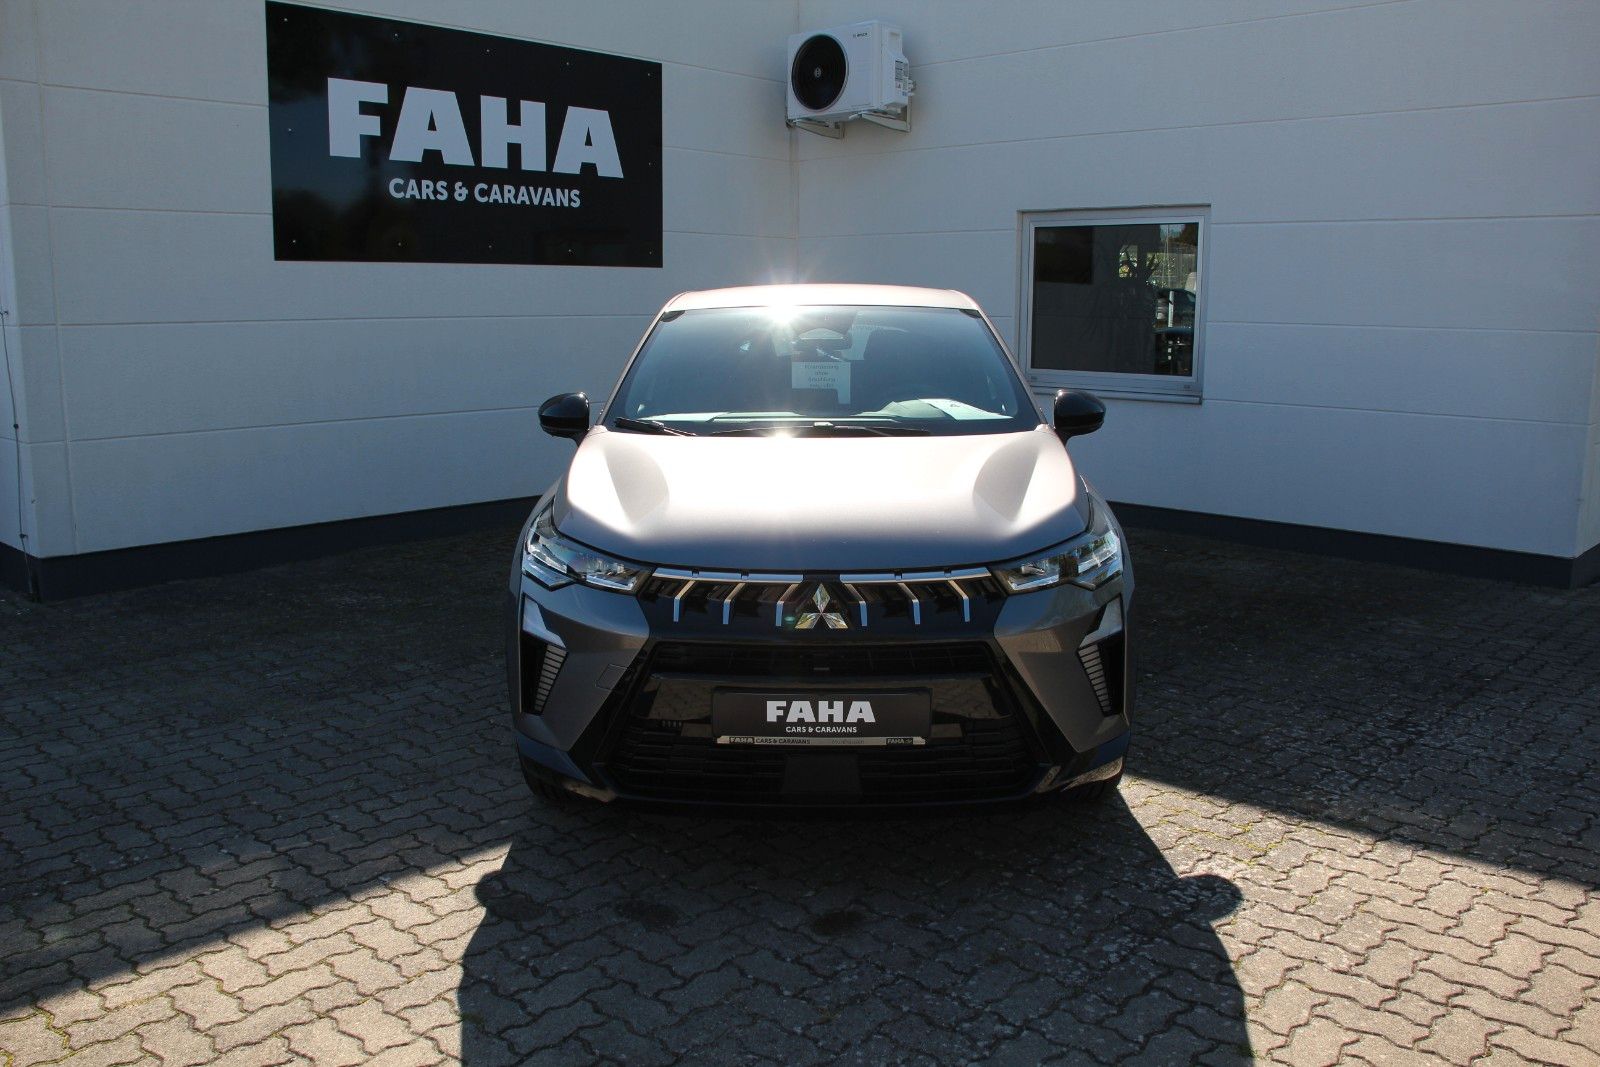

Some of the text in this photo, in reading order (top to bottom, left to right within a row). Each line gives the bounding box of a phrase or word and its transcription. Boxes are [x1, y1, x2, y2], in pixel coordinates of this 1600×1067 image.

[327, 77, 624, 178] FAHA
[388, 177, 581, 208] CARS & CARAVANS
[766, 700, 876, 722] FAHA
